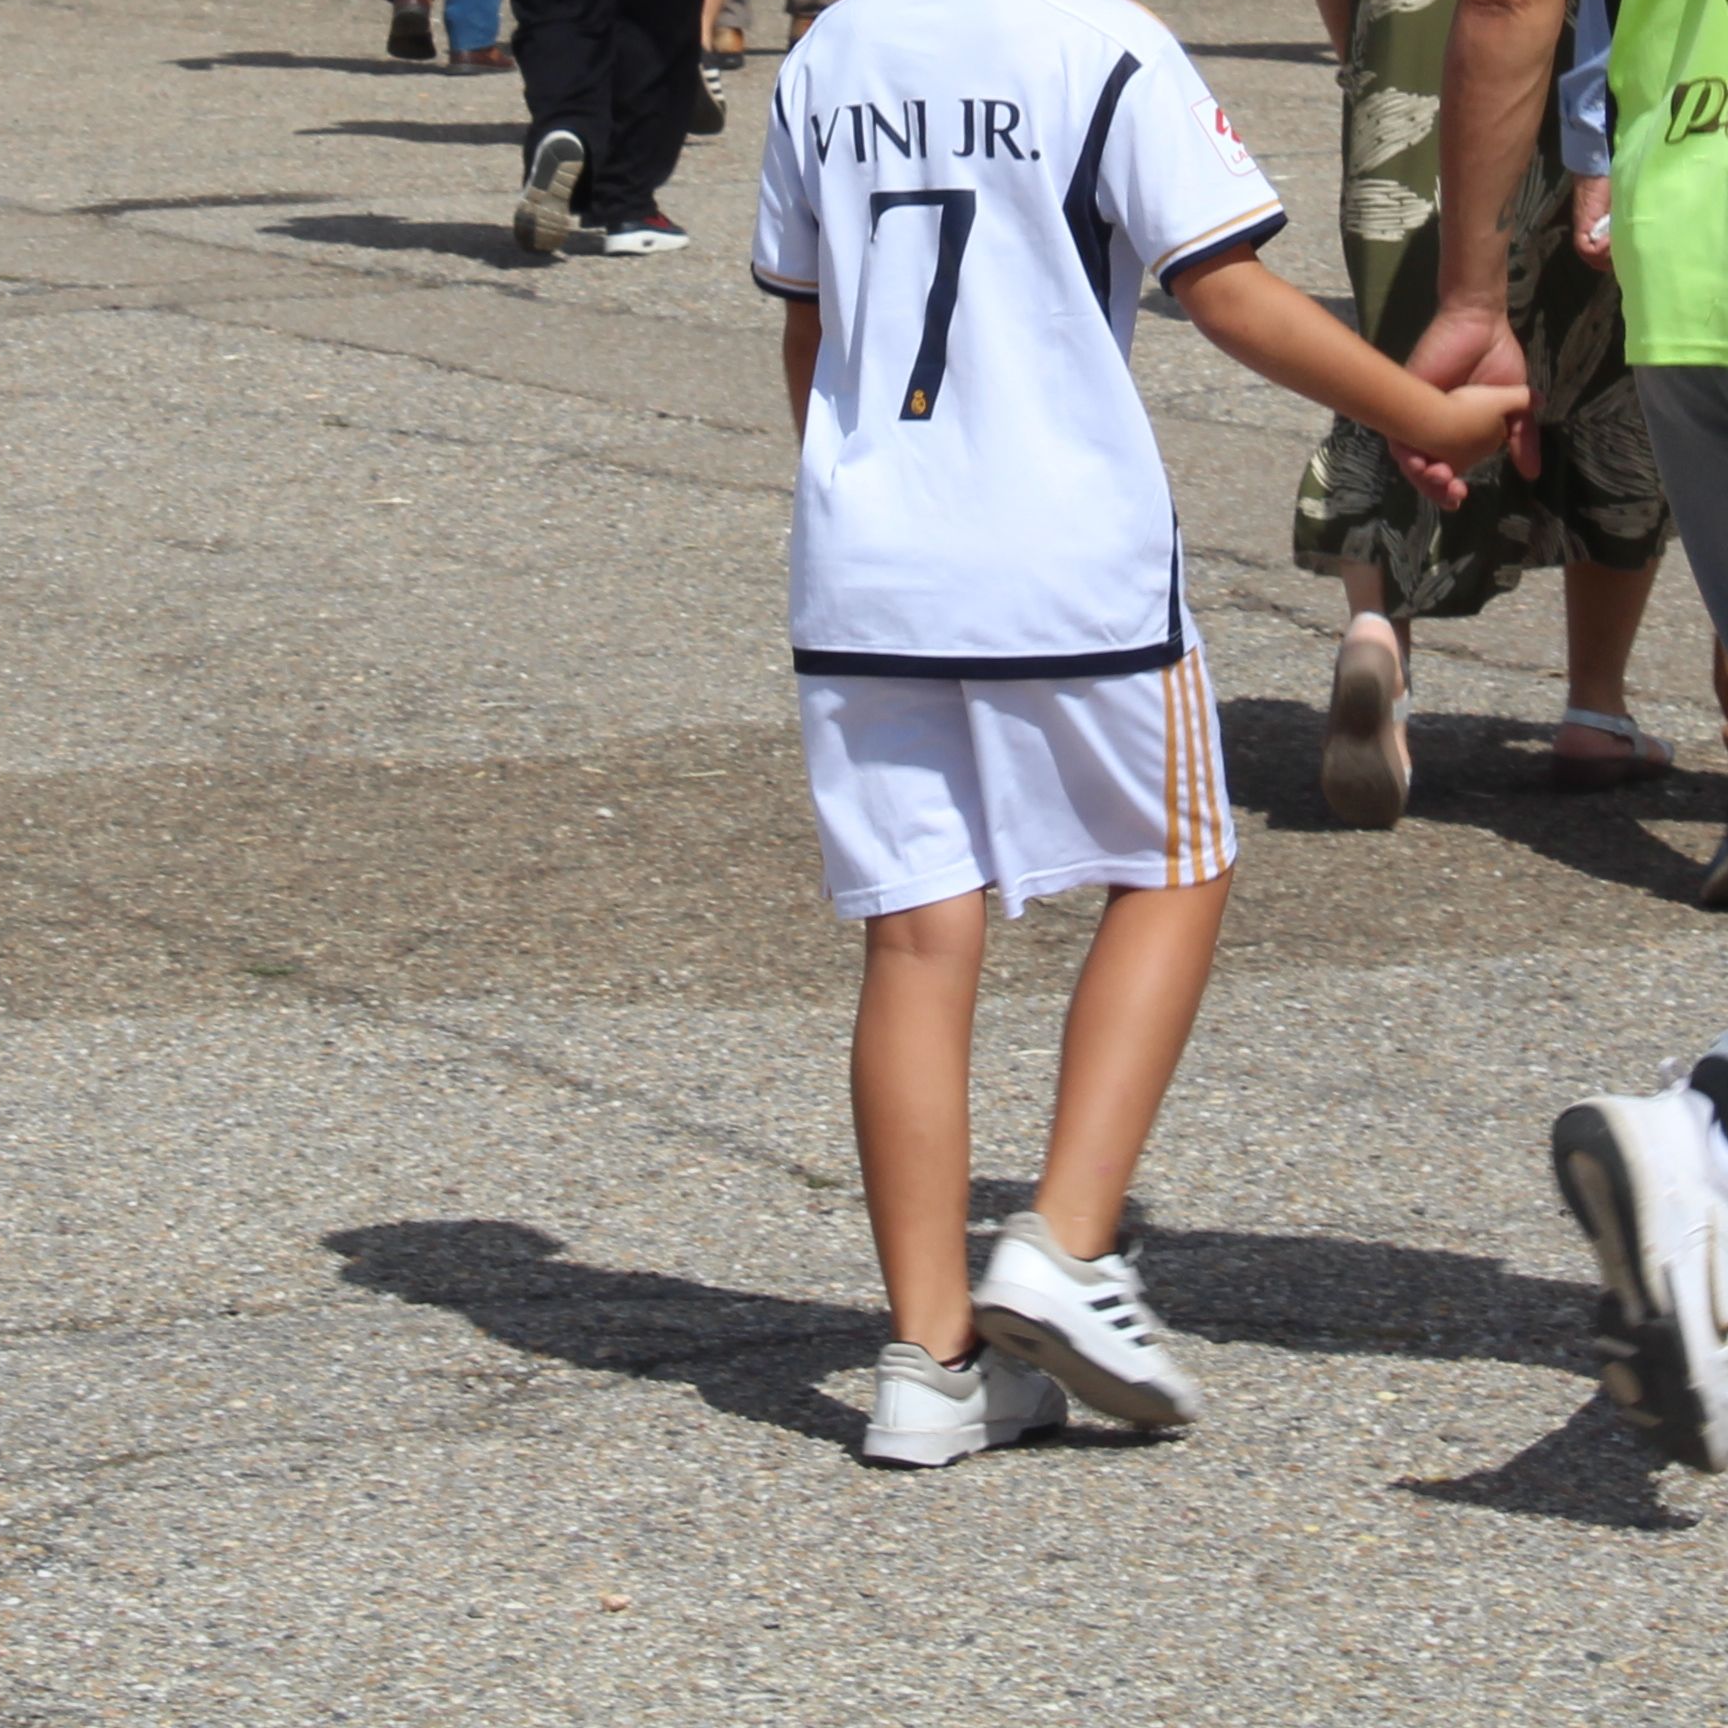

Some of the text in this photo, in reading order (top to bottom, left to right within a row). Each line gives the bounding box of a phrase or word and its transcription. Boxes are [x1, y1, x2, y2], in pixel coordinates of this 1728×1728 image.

[810, 97, 1042, 165] VINI JR.
[870, 188, 977, 421] 7
